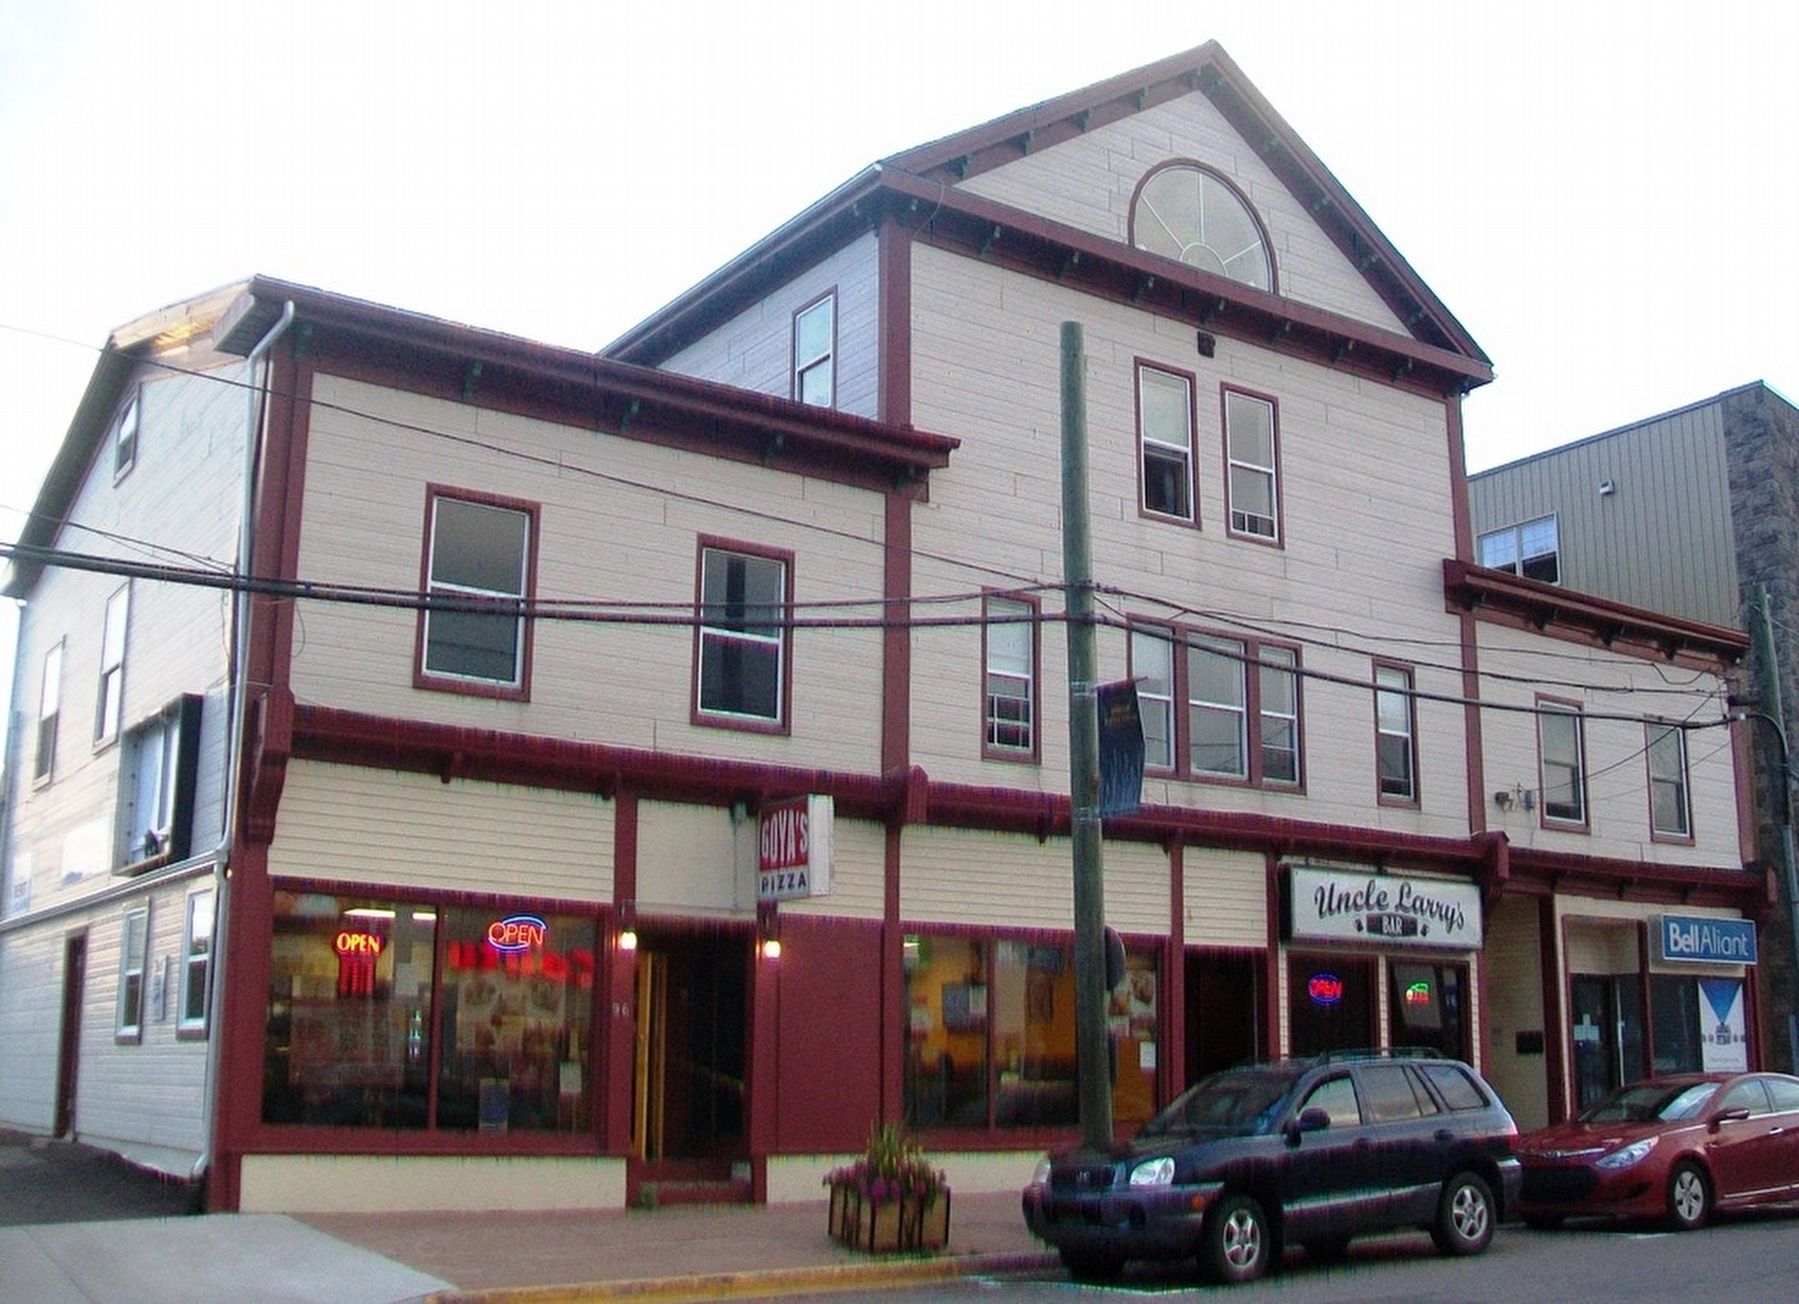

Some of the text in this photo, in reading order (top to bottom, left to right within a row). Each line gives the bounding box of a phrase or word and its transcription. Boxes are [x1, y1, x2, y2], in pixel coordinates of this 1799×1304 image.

[761, 872, 807, 893] PIZZA
[1314, 879, 1465, 934] Uncle Larry's
[488, 921, 544, 945] OPEN
[1382, 915, 1403, 935] BAR
[337, 932, 380, 955] OPEN
